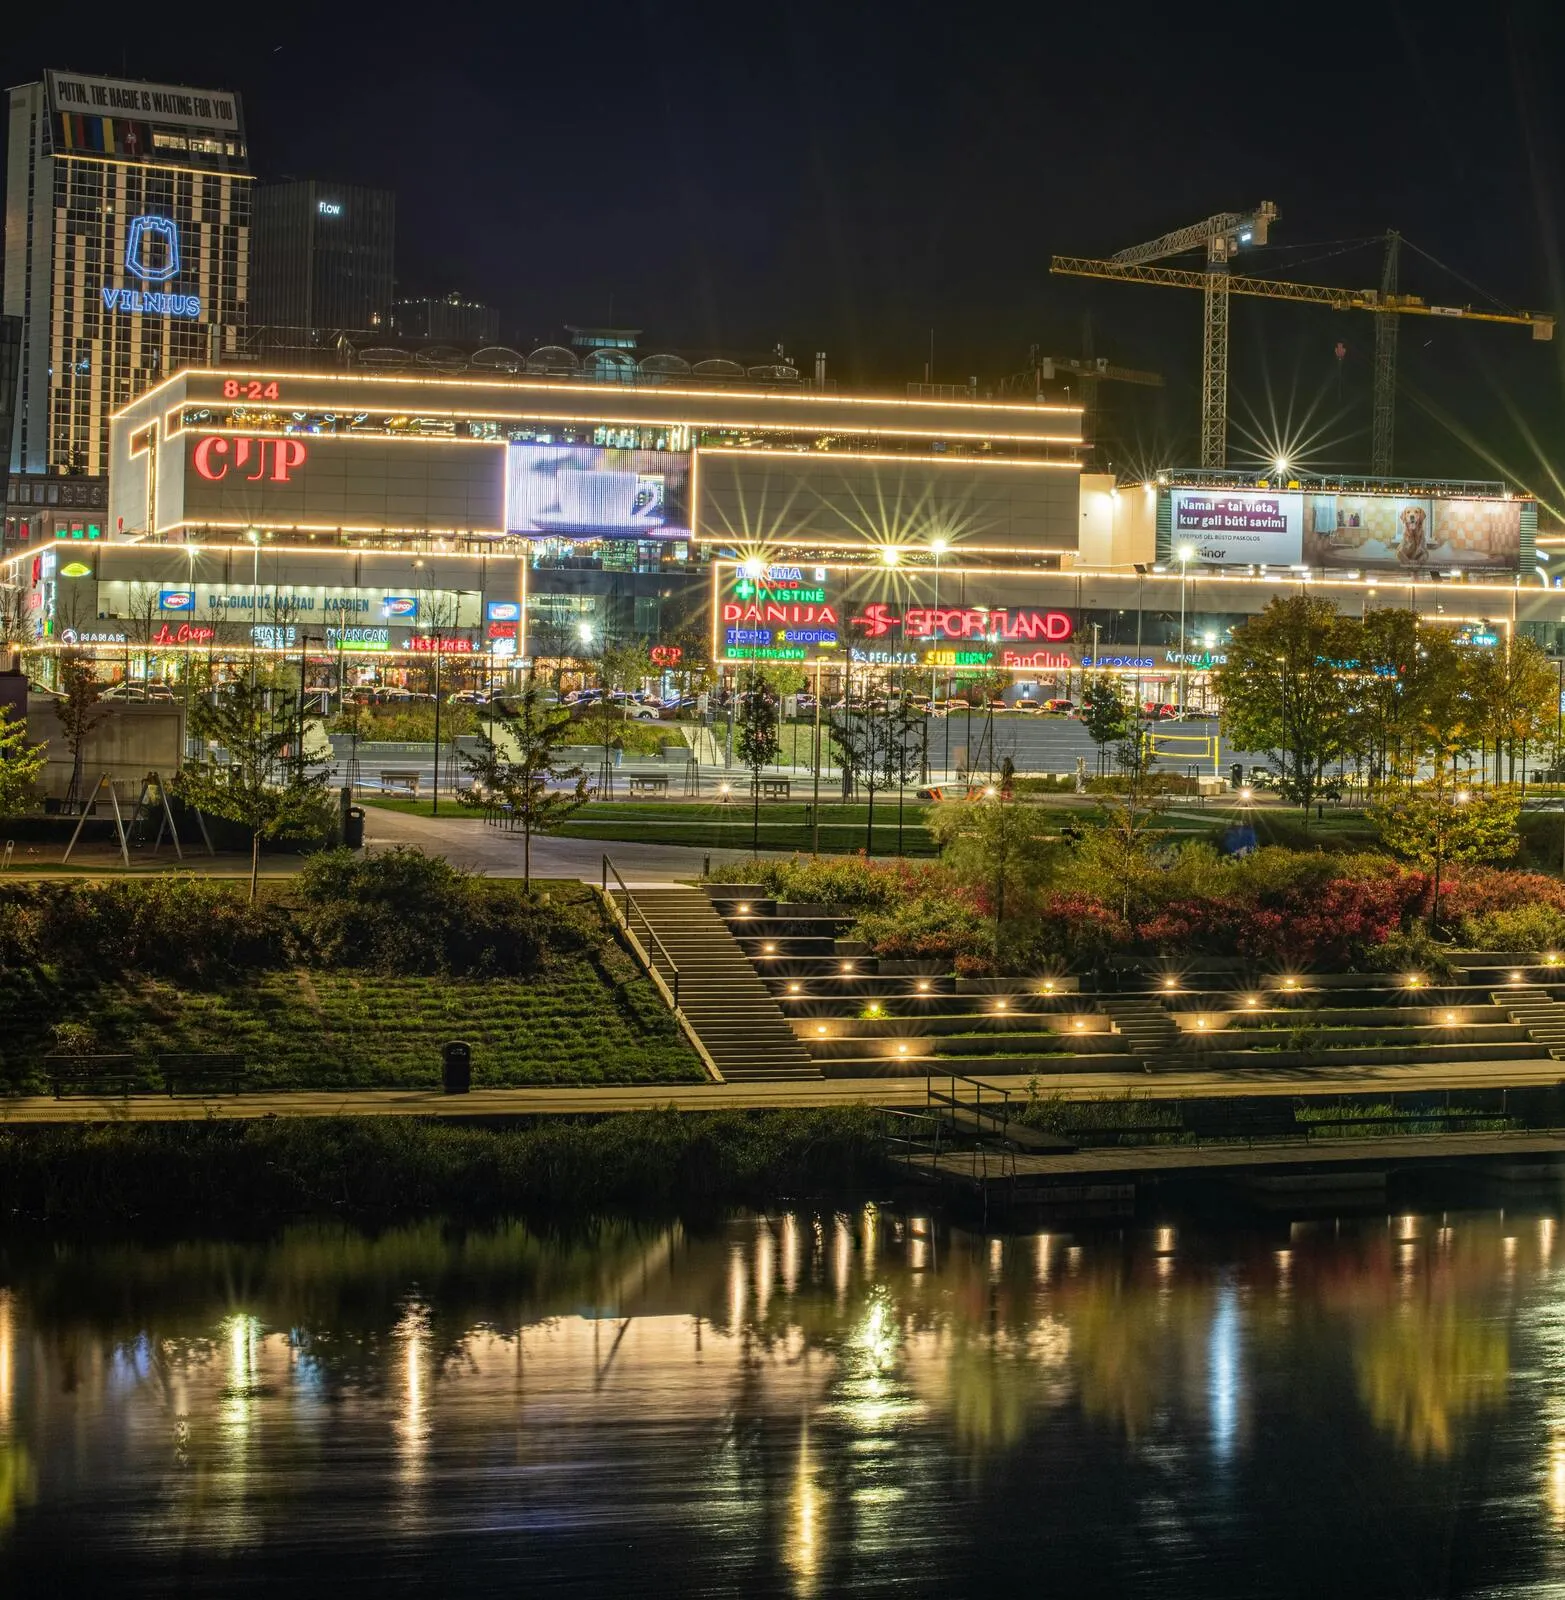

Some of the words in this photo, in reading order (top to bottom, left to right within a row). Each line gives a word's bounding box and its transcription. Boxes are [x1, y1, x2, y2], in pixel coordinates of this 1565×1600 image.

[58, 81, 89, 104] PUTIN,
[90, 85, 109, 106] THE
[109, 87, 140, 110] HAGUE
[141, 91, 150, 111] IS
[151, 92, 192, 115] WAITING
[194, 97, 212, 118] FOR
[213, 99, 233, 121] YOU
[320, 201, 340, 214] flow
[102, 287, 201, 317] VILNIUS
[224, 379, 279, 400] 8-24
[193, 435, 307, 482] CUP
[1180, 499, 1215, 511] Namai
[1228, 501, 1242, 512] tai
[1245, 502, 1277, 514] vieta,
[1180, 514, 1199, 525] kur
[1201, 515, 1222, 528] gali
[1225, 515, 1247, 528] būti
[1250, 517, 1285, 528] savimi
[736, 566, 802, 580] MXIMA
[258, 593, 271, 609] UŽ
[758, 588, 825, 602] VISTINĖ
[723, 604, 837, 623] DANIJA
[904, 608, 1072, 640] SPORTLAND
[153, 624, 176, 645] La
[336, 628, 361, 641] CAN
[362, 628, 389, 642] CAN
[785, 630, 837, 641] euronics
[1003, 652, 1071, 668] FamClub
[1081, 655, 1153, 667] eurokos
